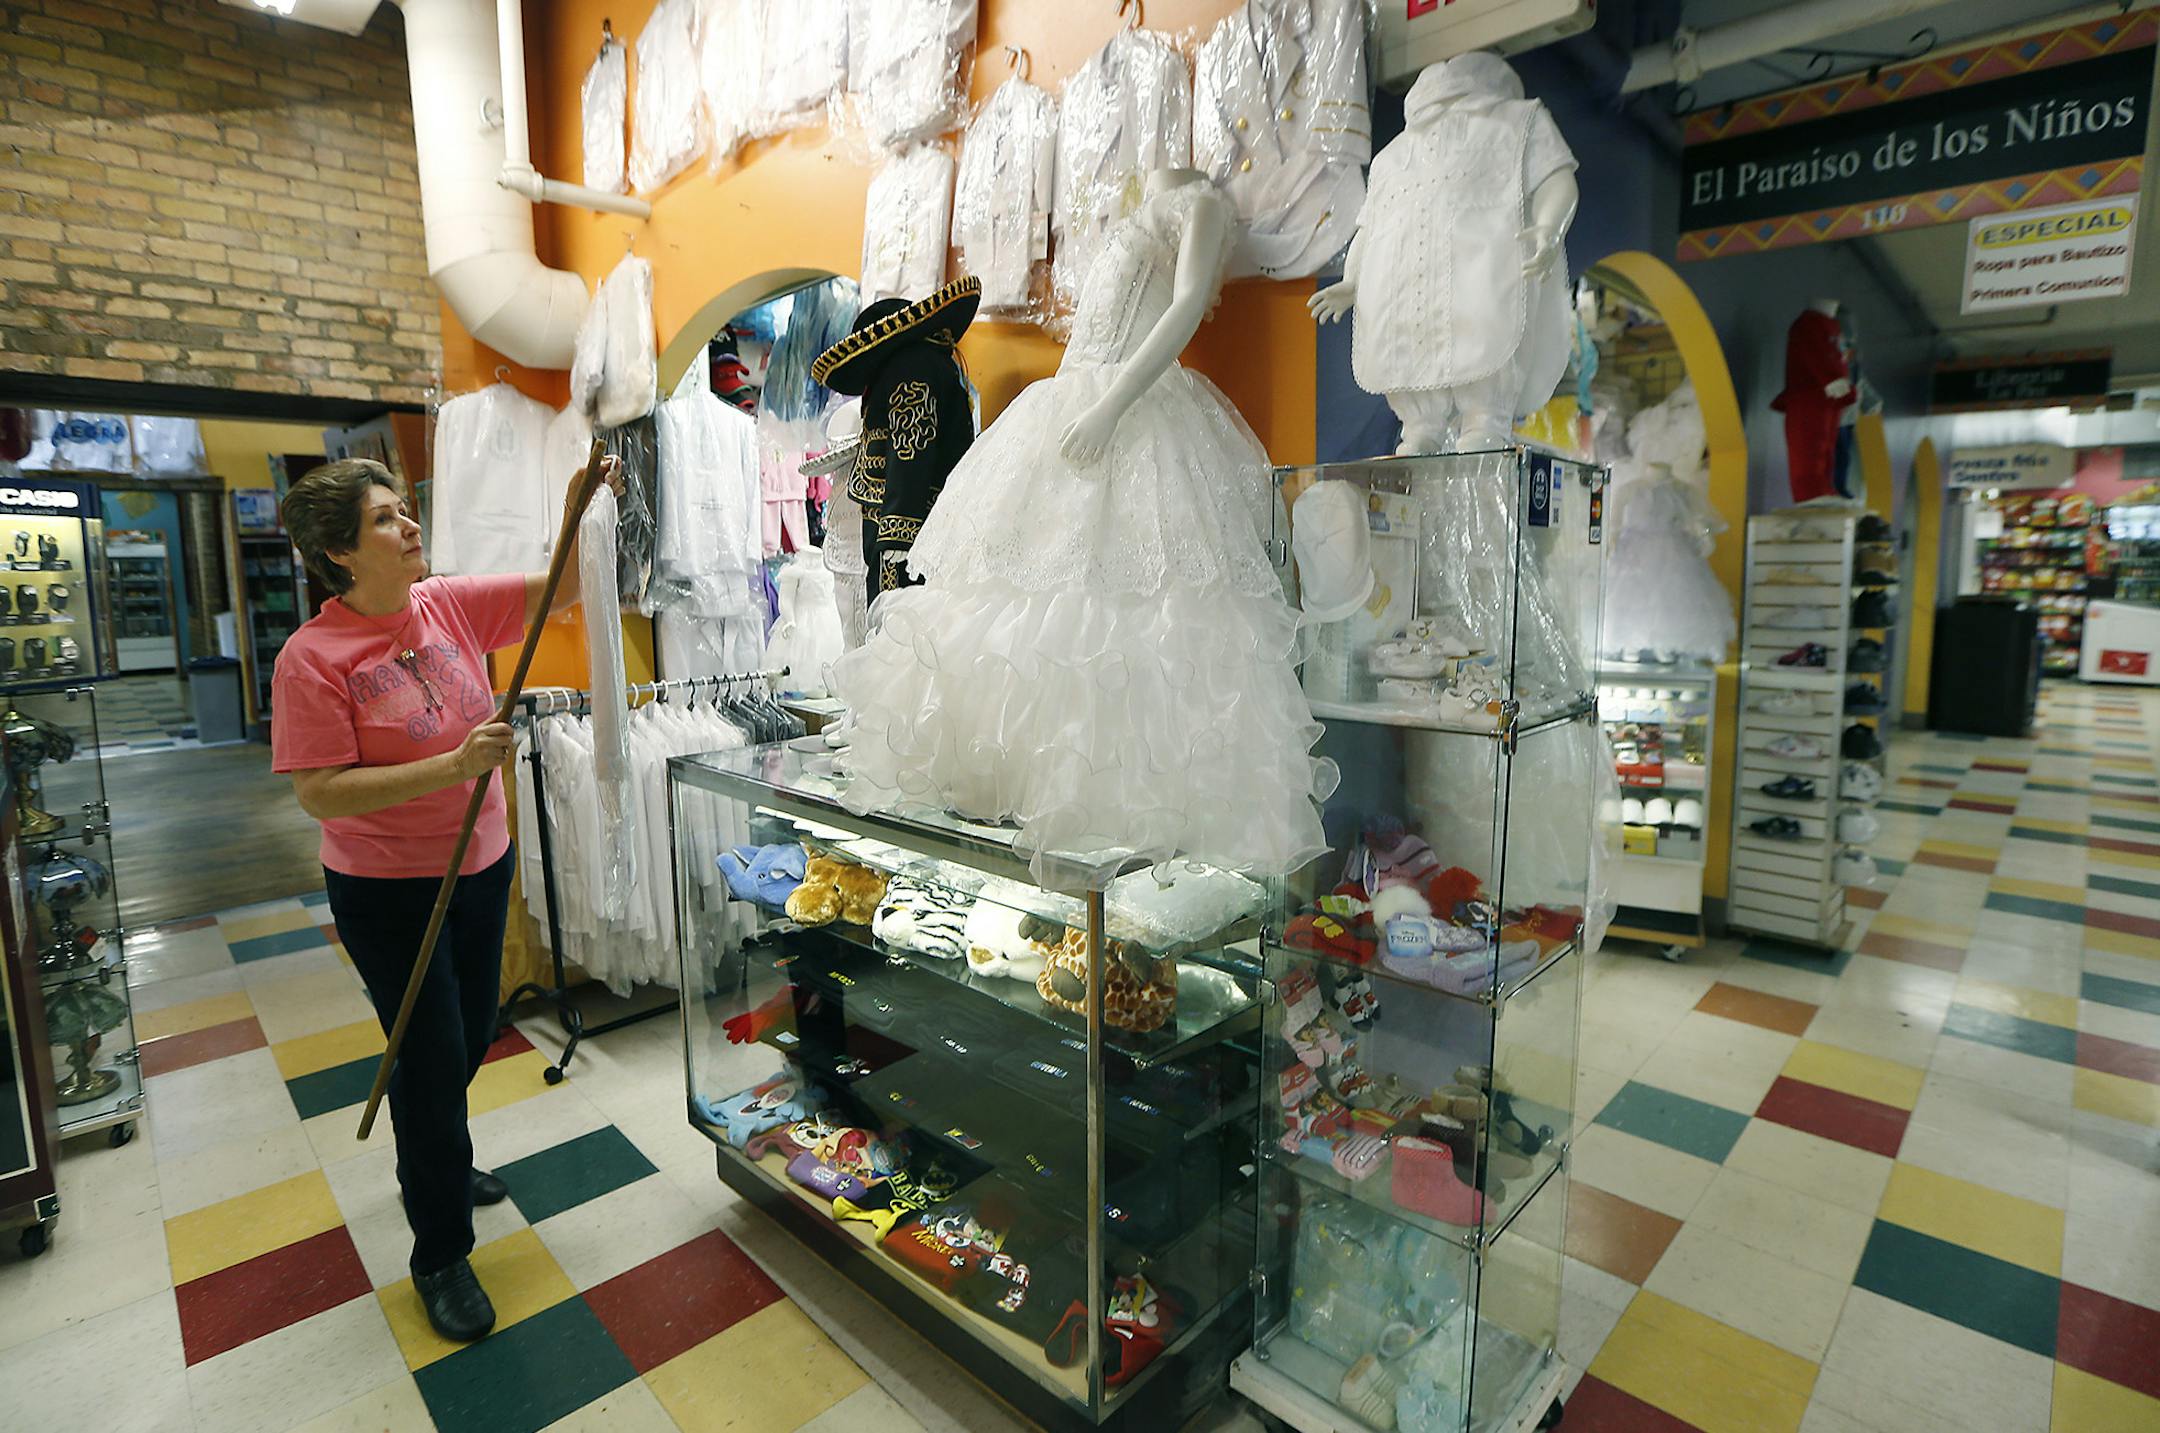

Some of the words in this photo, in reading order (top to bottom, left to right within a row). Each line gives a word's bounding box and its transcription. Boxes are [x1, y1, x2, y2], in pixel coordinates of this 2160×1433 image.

[1691, 167, 1725, 205] El
[1736, 147, 1861, 197] Paraiso
[1873, 131, 1918, 172] de
[1930, 122, 1990, 162] los
[2003, 96, 2136, 148] Niños
[1859, 204, 1909, 230] 110
[1982, 211, 2125, 244] ESPECIAL
[1974, 258, 2016, 273] Ropa
[2019, 253, 2057, 270] para
[2061, 245, 2128, 262] Bautizo
[1970, 285, 2032, 302] Primera
[0, 488, 79, 509] CASIO
[1390, 935, 1428, 944] FROZEN
